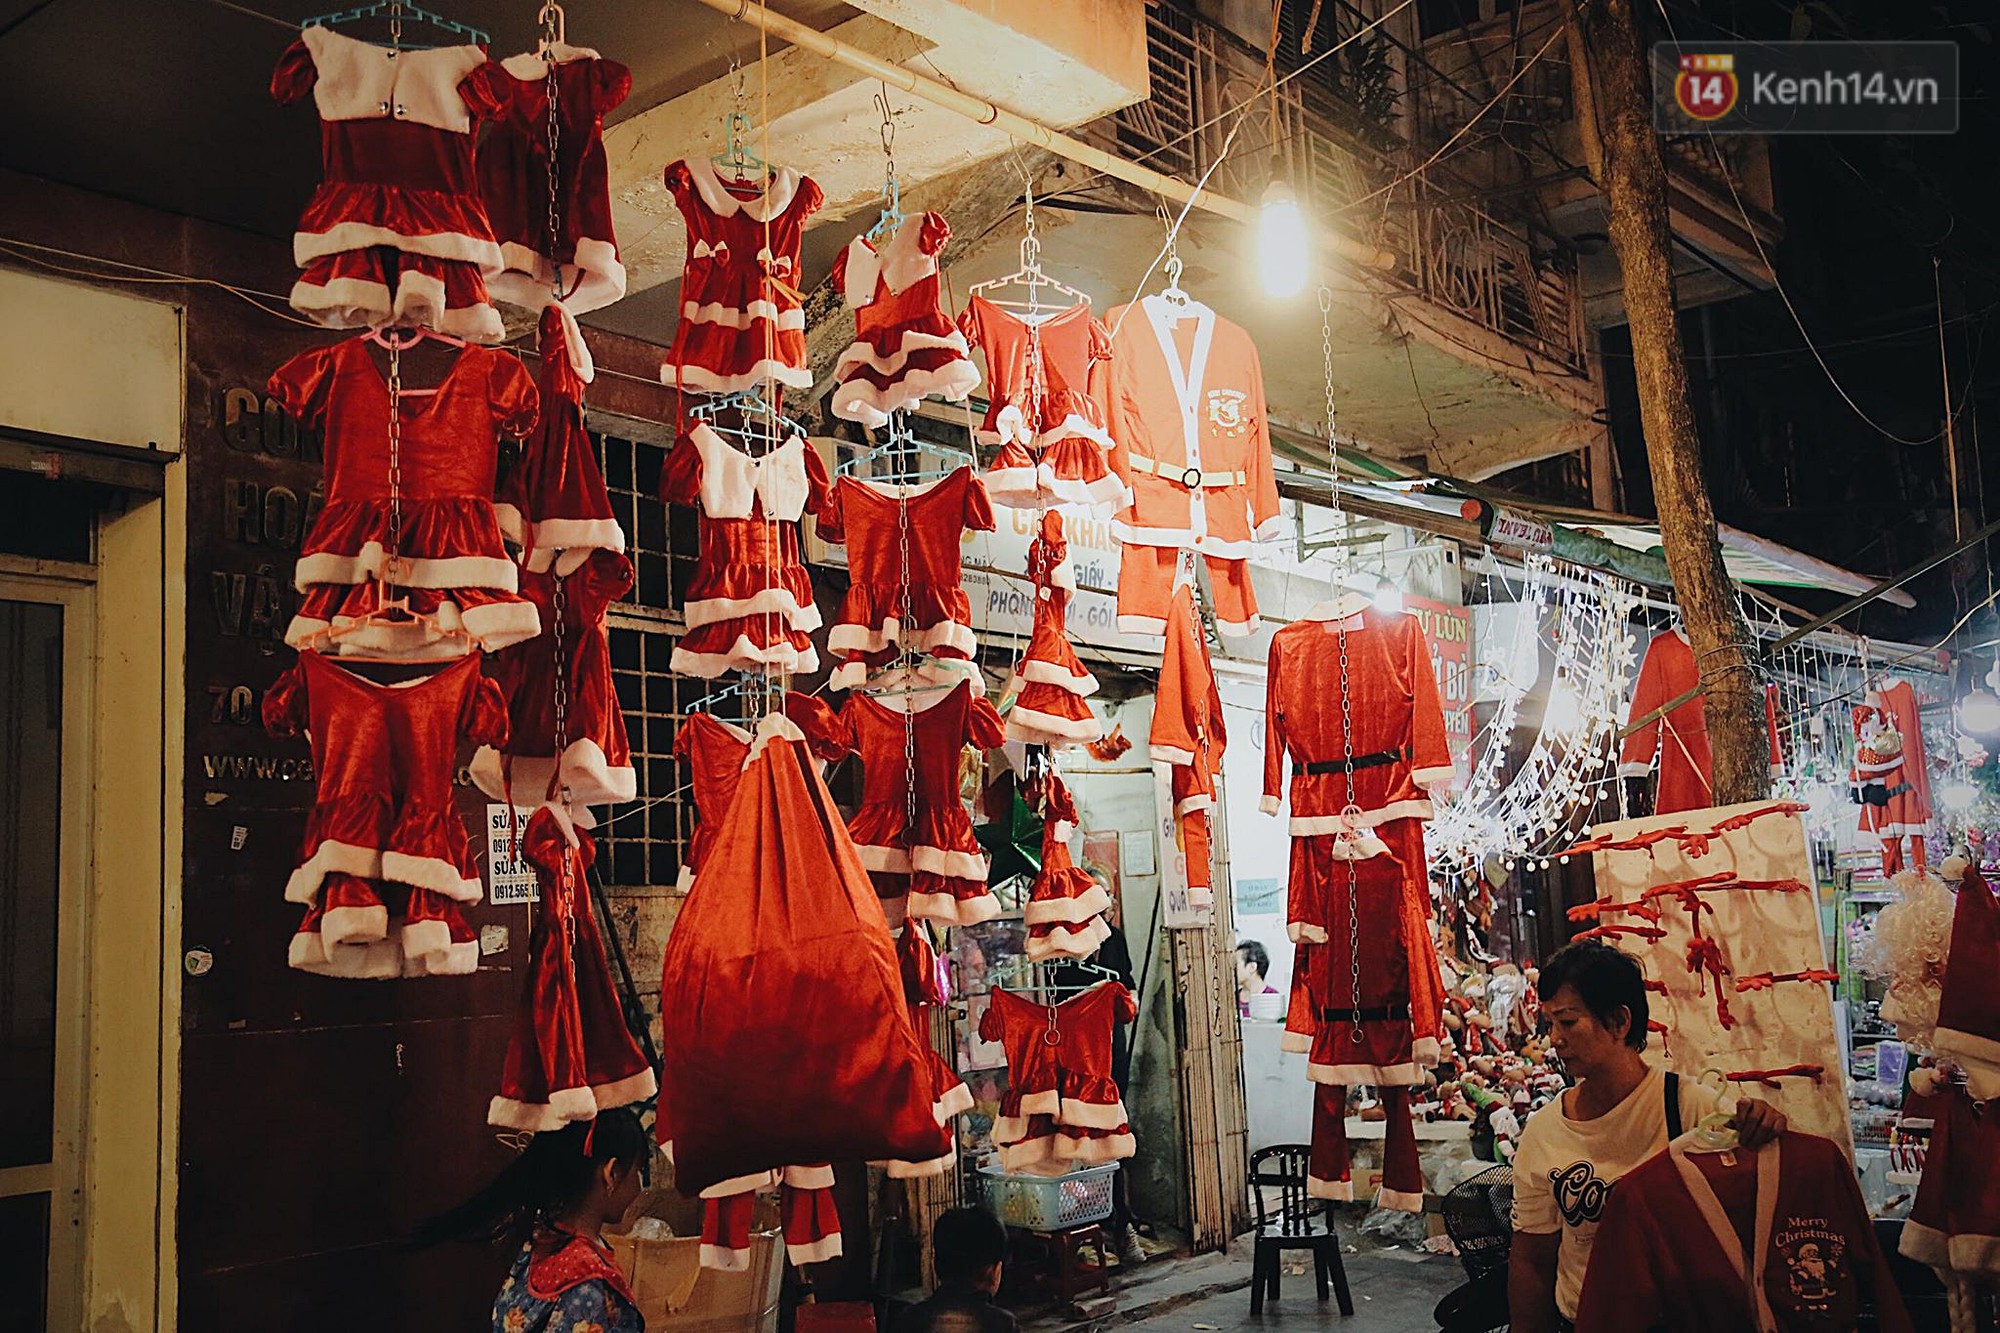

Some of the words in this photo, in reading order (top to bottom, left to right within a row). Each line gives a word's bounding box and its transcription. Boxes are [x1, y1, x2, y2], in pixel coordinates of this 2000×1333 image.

[1446, 652, 1468, 702] BÒ
[1788, 1217, 1828, 1229] Merry
[1775, 1229, 1846, 1248] Christmas
